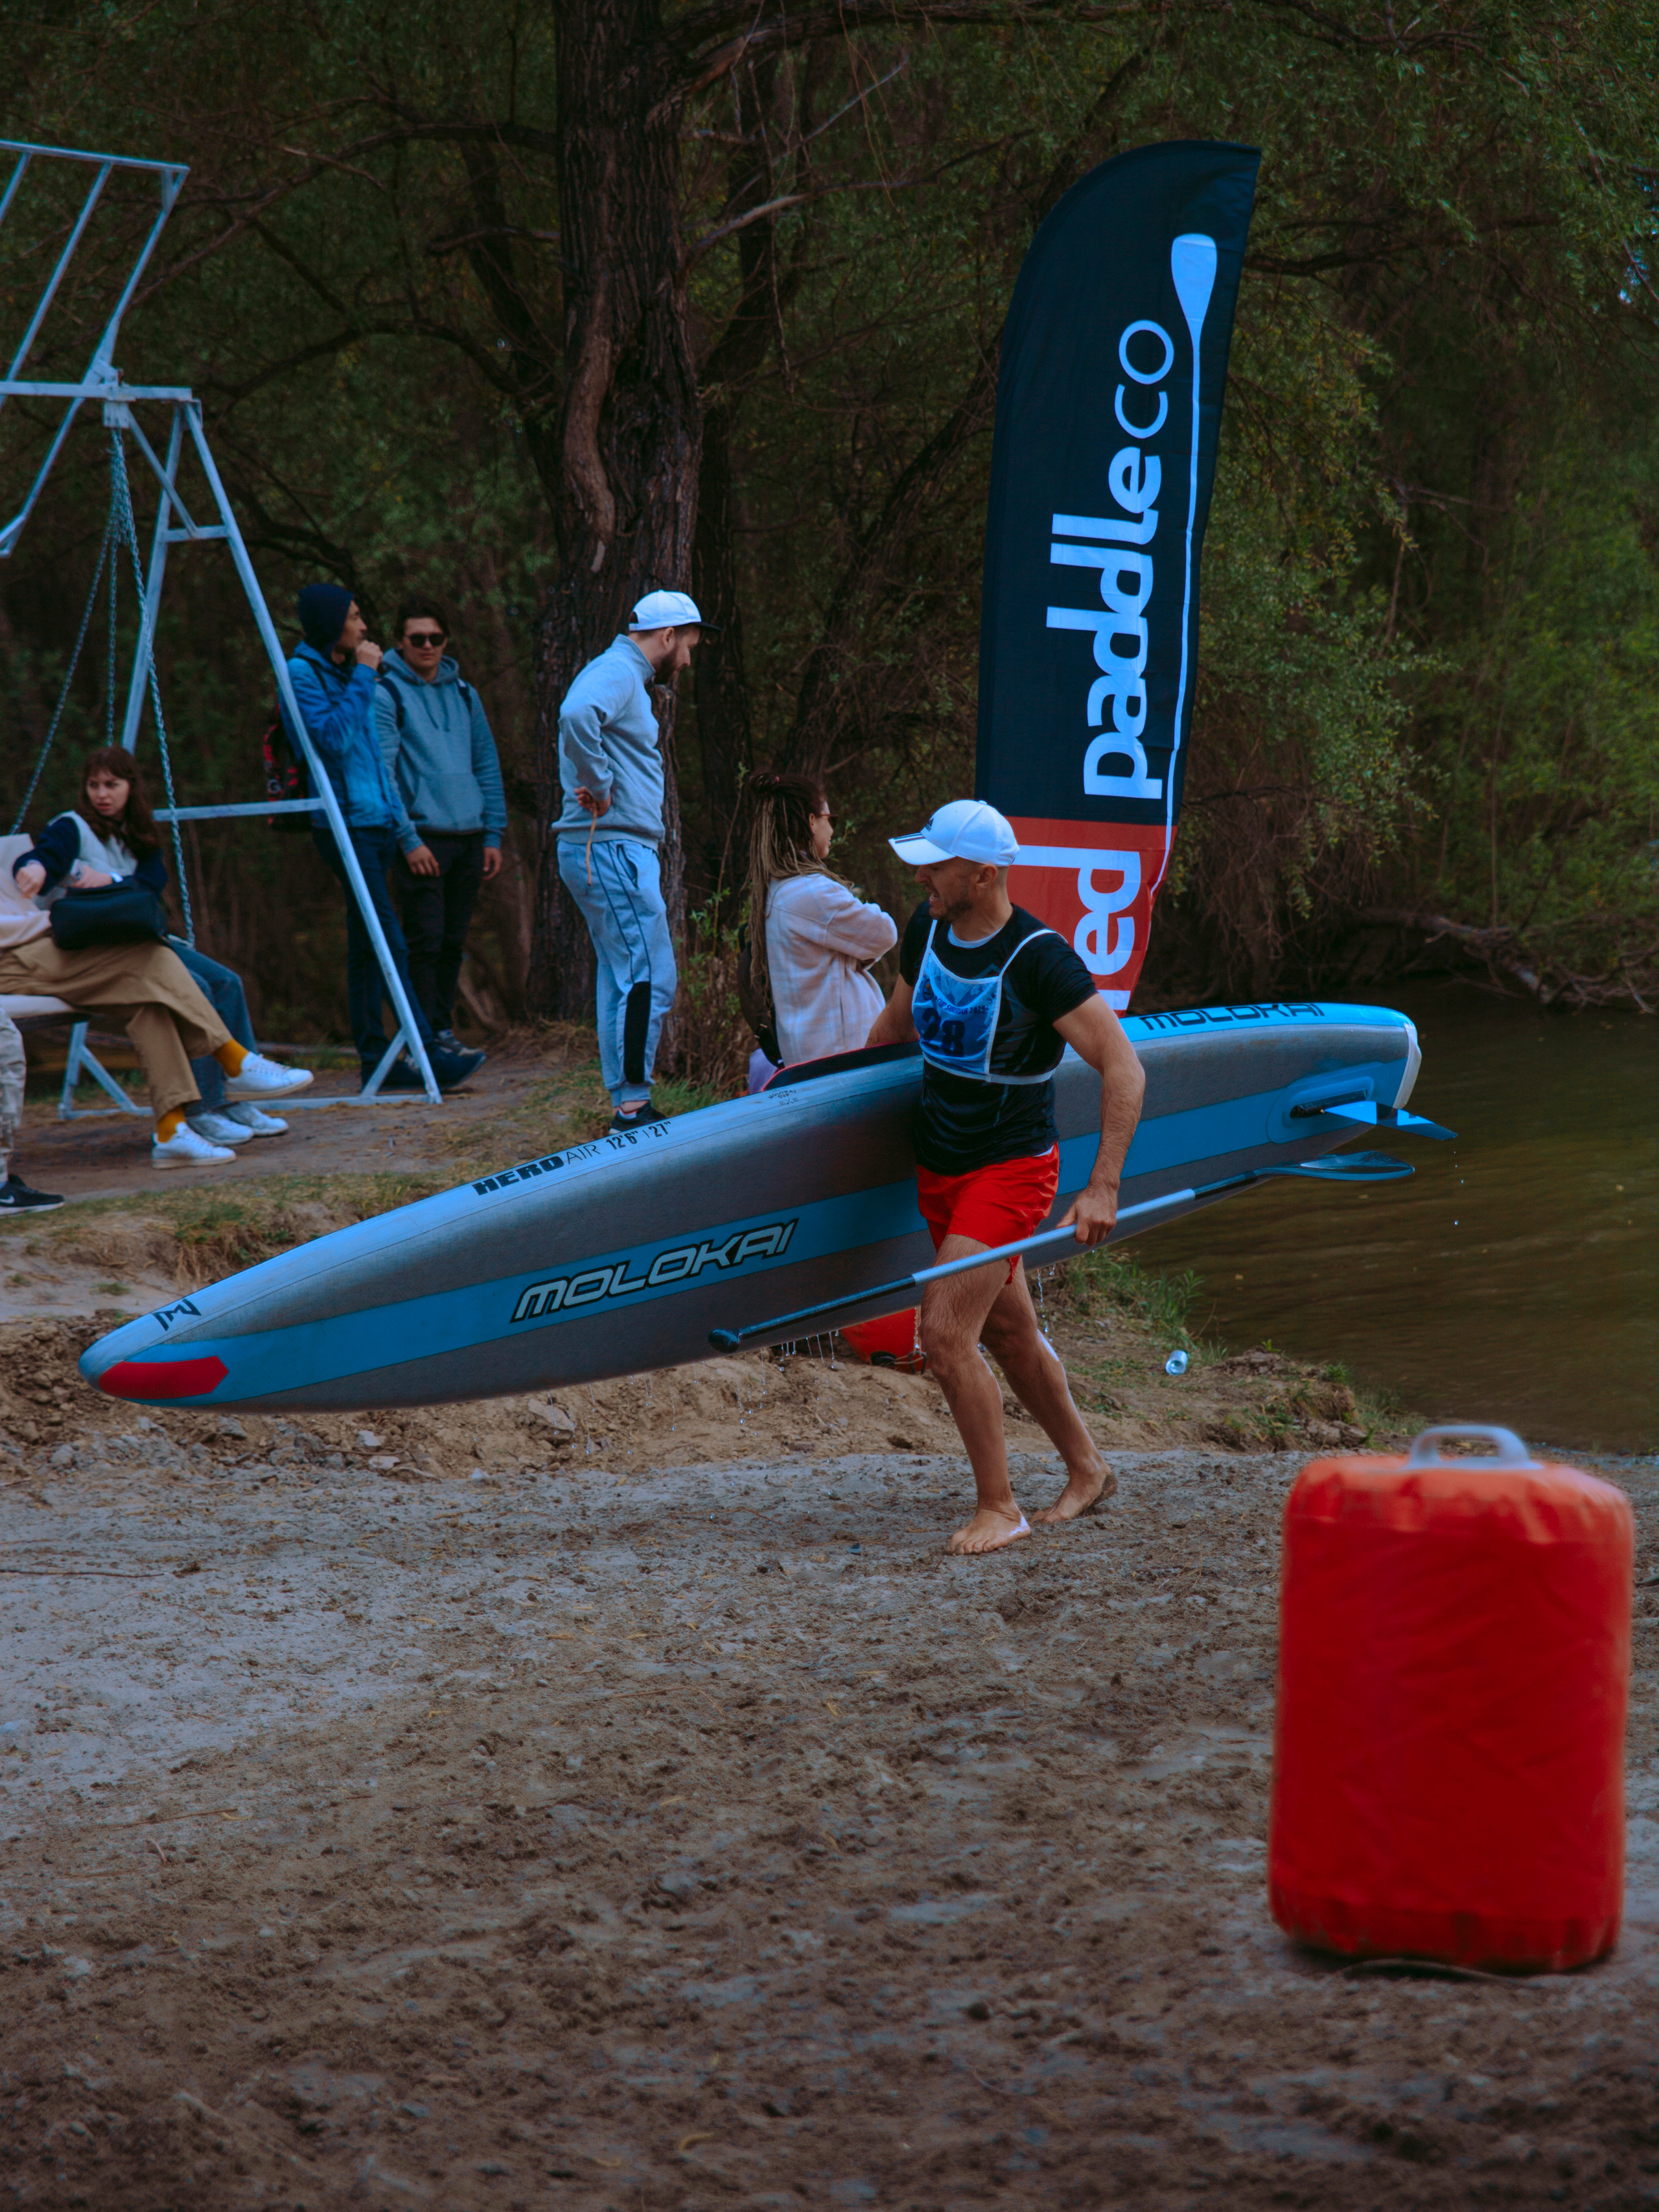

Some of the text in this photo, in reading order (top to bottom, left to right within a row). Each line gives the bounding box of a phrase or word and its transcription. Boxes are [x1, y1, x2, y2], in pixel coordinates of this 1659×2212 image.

[922, 1008, 965, 1057] 28
[1139, 1003, 1325, 1030] MOLOKAI
[511, 1218, 798, 1323] MOLOKAI
